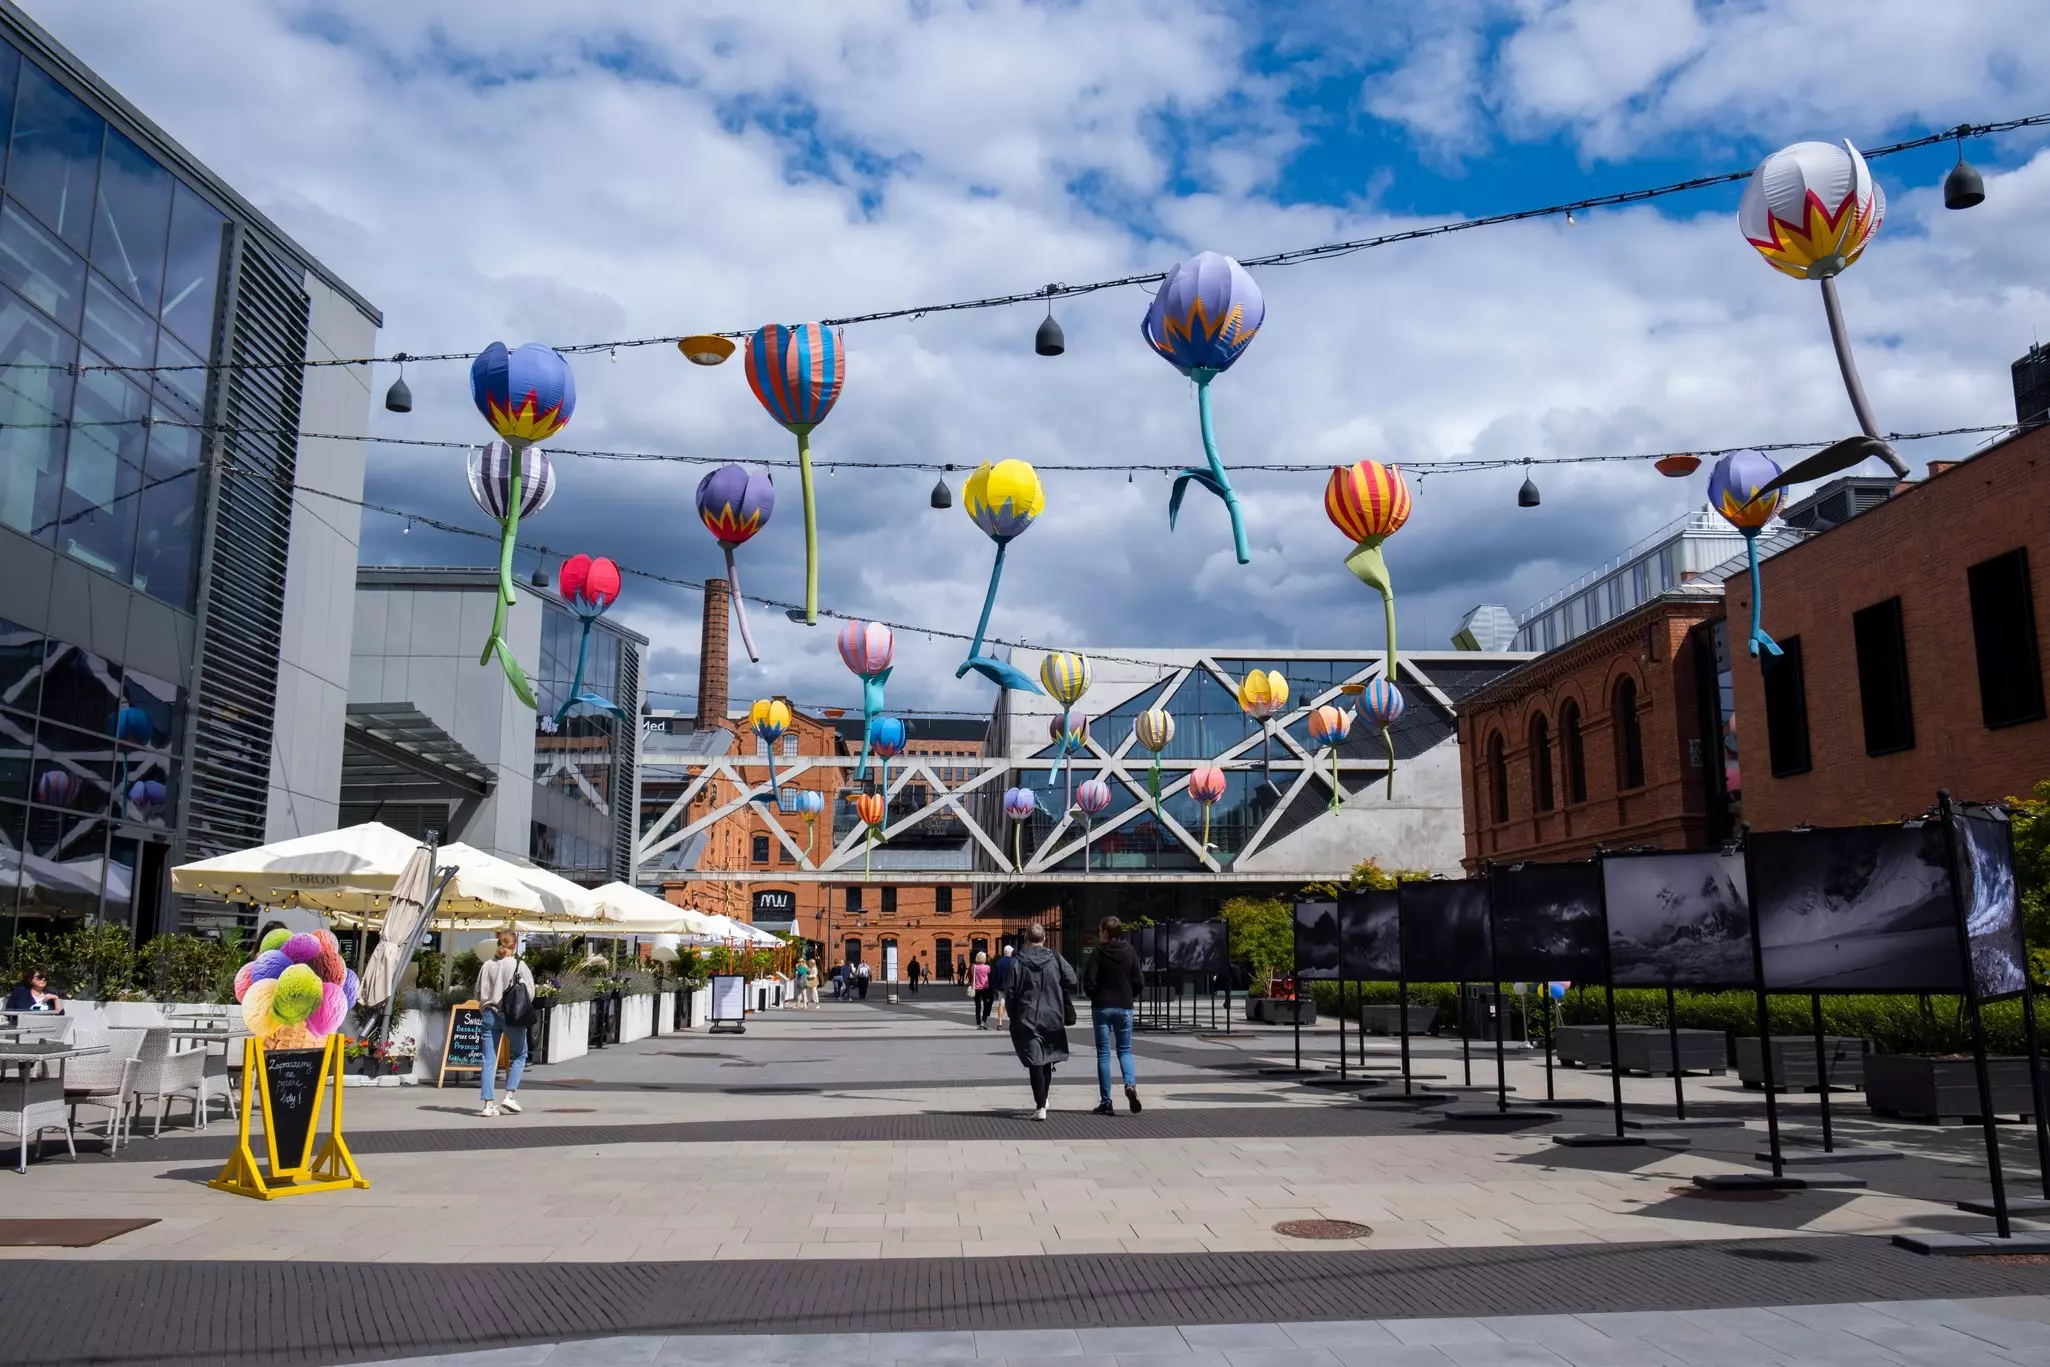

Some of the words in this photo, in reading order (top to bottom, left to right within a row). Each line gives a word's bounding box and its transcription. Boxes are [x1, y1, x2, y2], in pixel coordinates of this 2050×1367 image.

[289, 872, 339, 885] PERONI
[464, 1011, 483, 1026] Śnia
[456, 1025, 482, 1033] Breakfa
[454, 1041, 480, 1051] Prosecco
[468, 1050, 483, 1060] Aper
[269, 1059, 314, 1075] Zapraszamy
[284, 1071, 297, 1079] na
